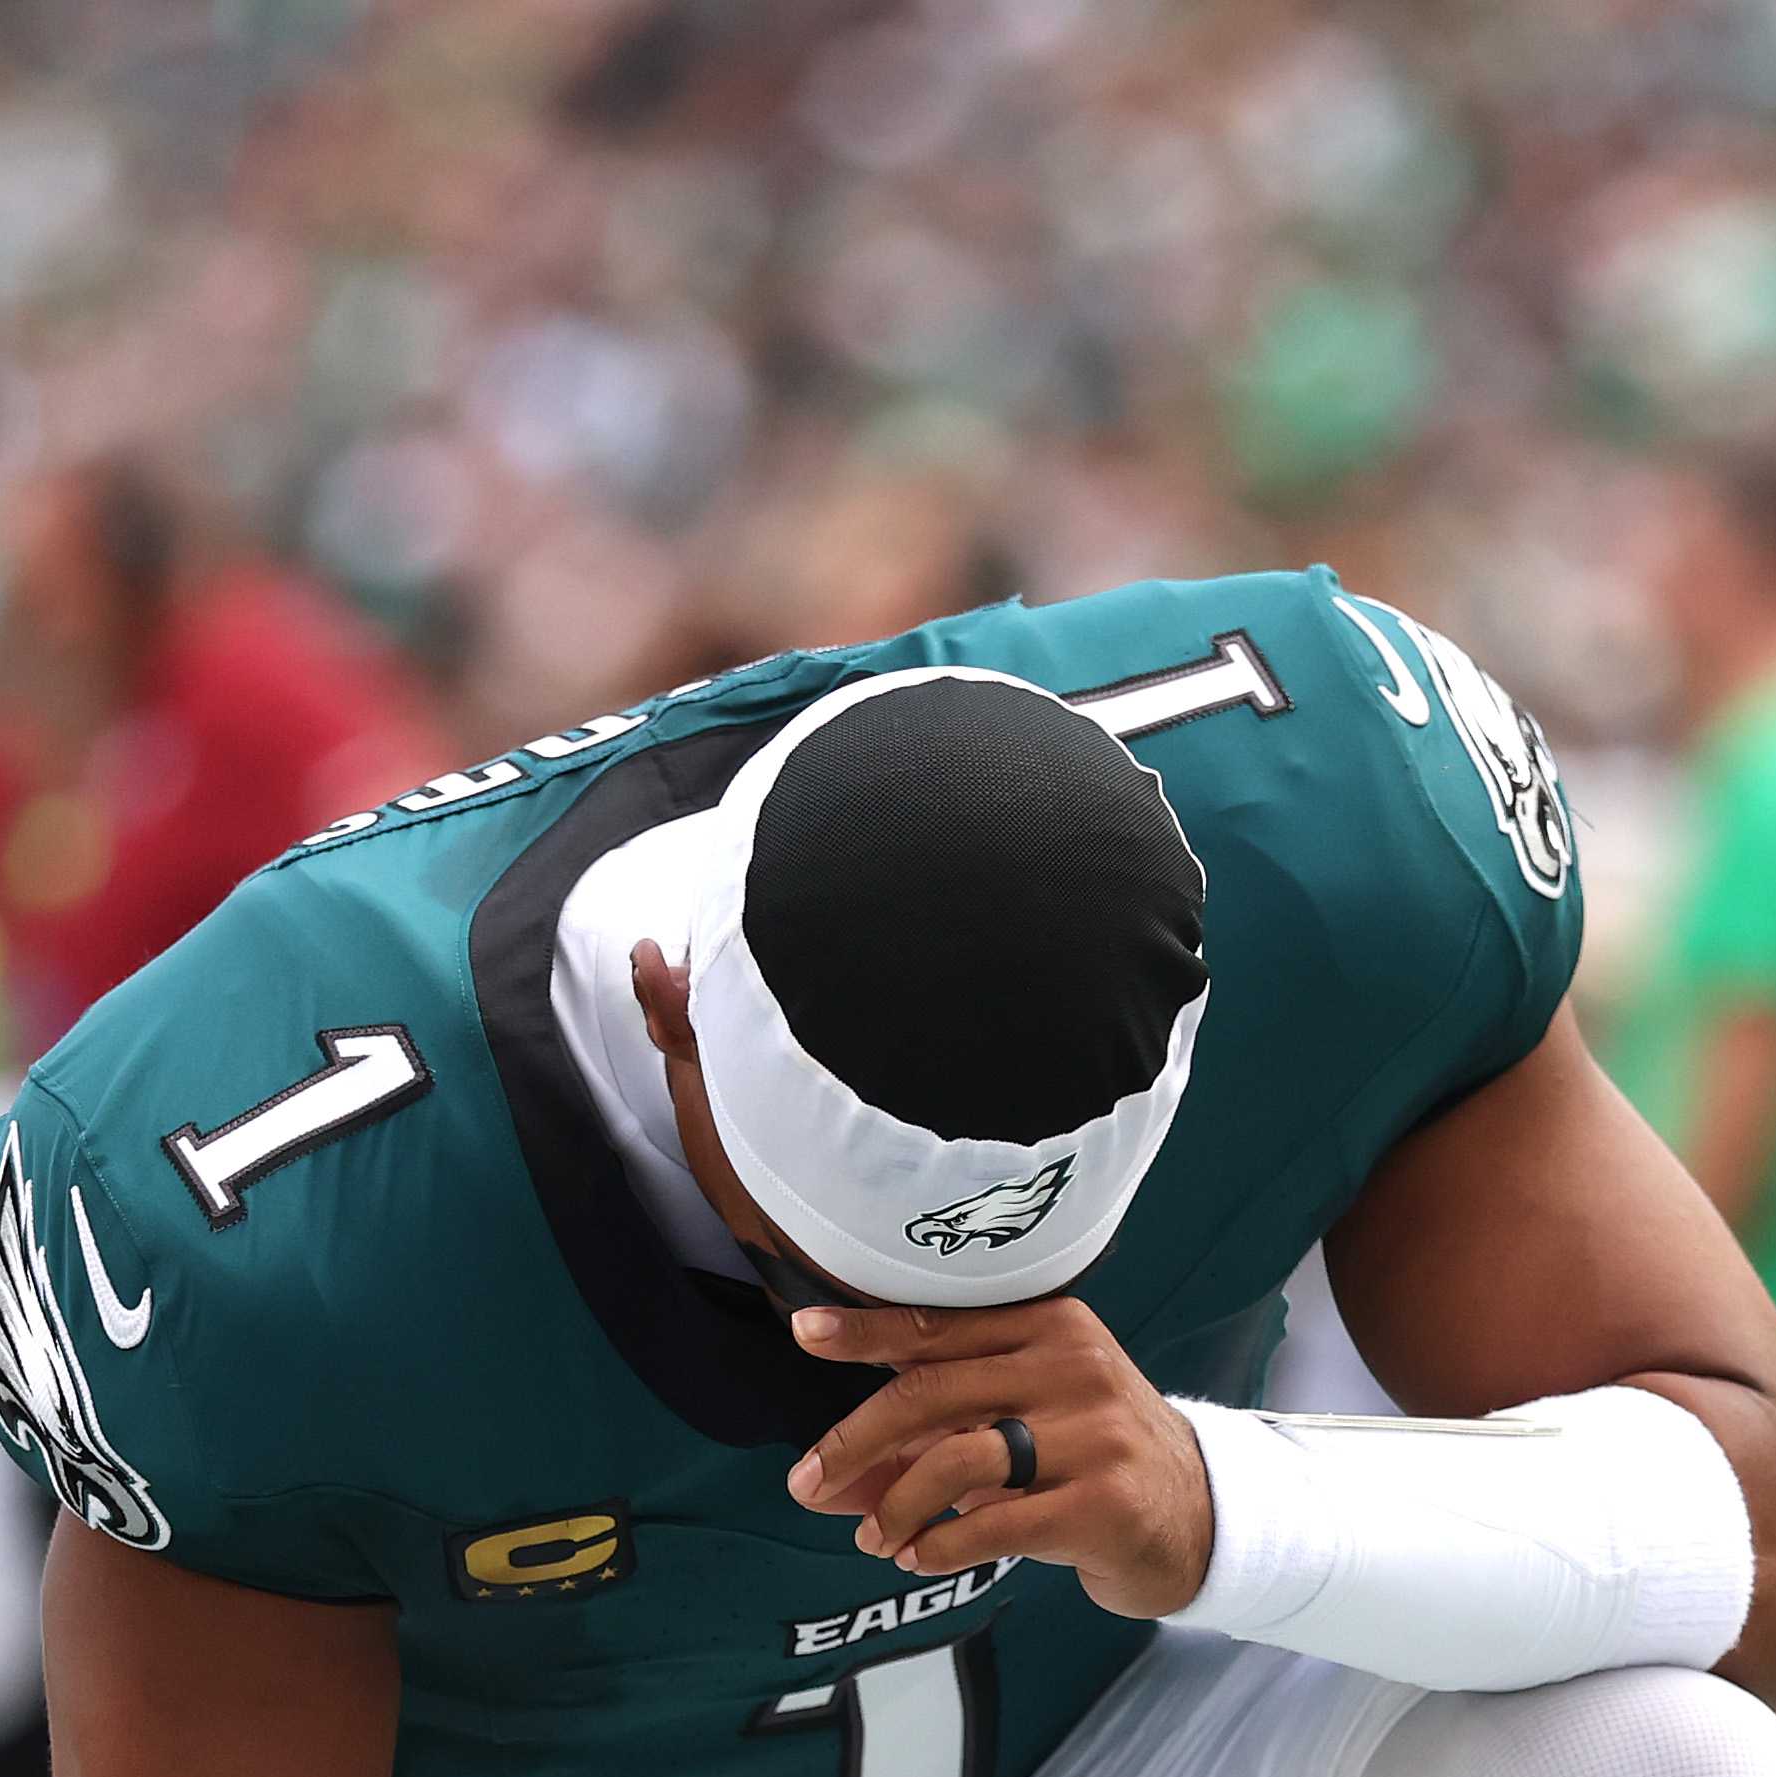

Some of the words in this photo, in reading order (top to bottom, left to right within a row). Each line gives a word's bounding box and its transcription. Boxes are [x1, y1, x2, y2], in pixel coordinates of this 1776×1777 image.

[163, 1026, 433, 1230] 1
[463, 1514, 619, 1586] C
[792, 1554, 1023, 1657] EAGL
